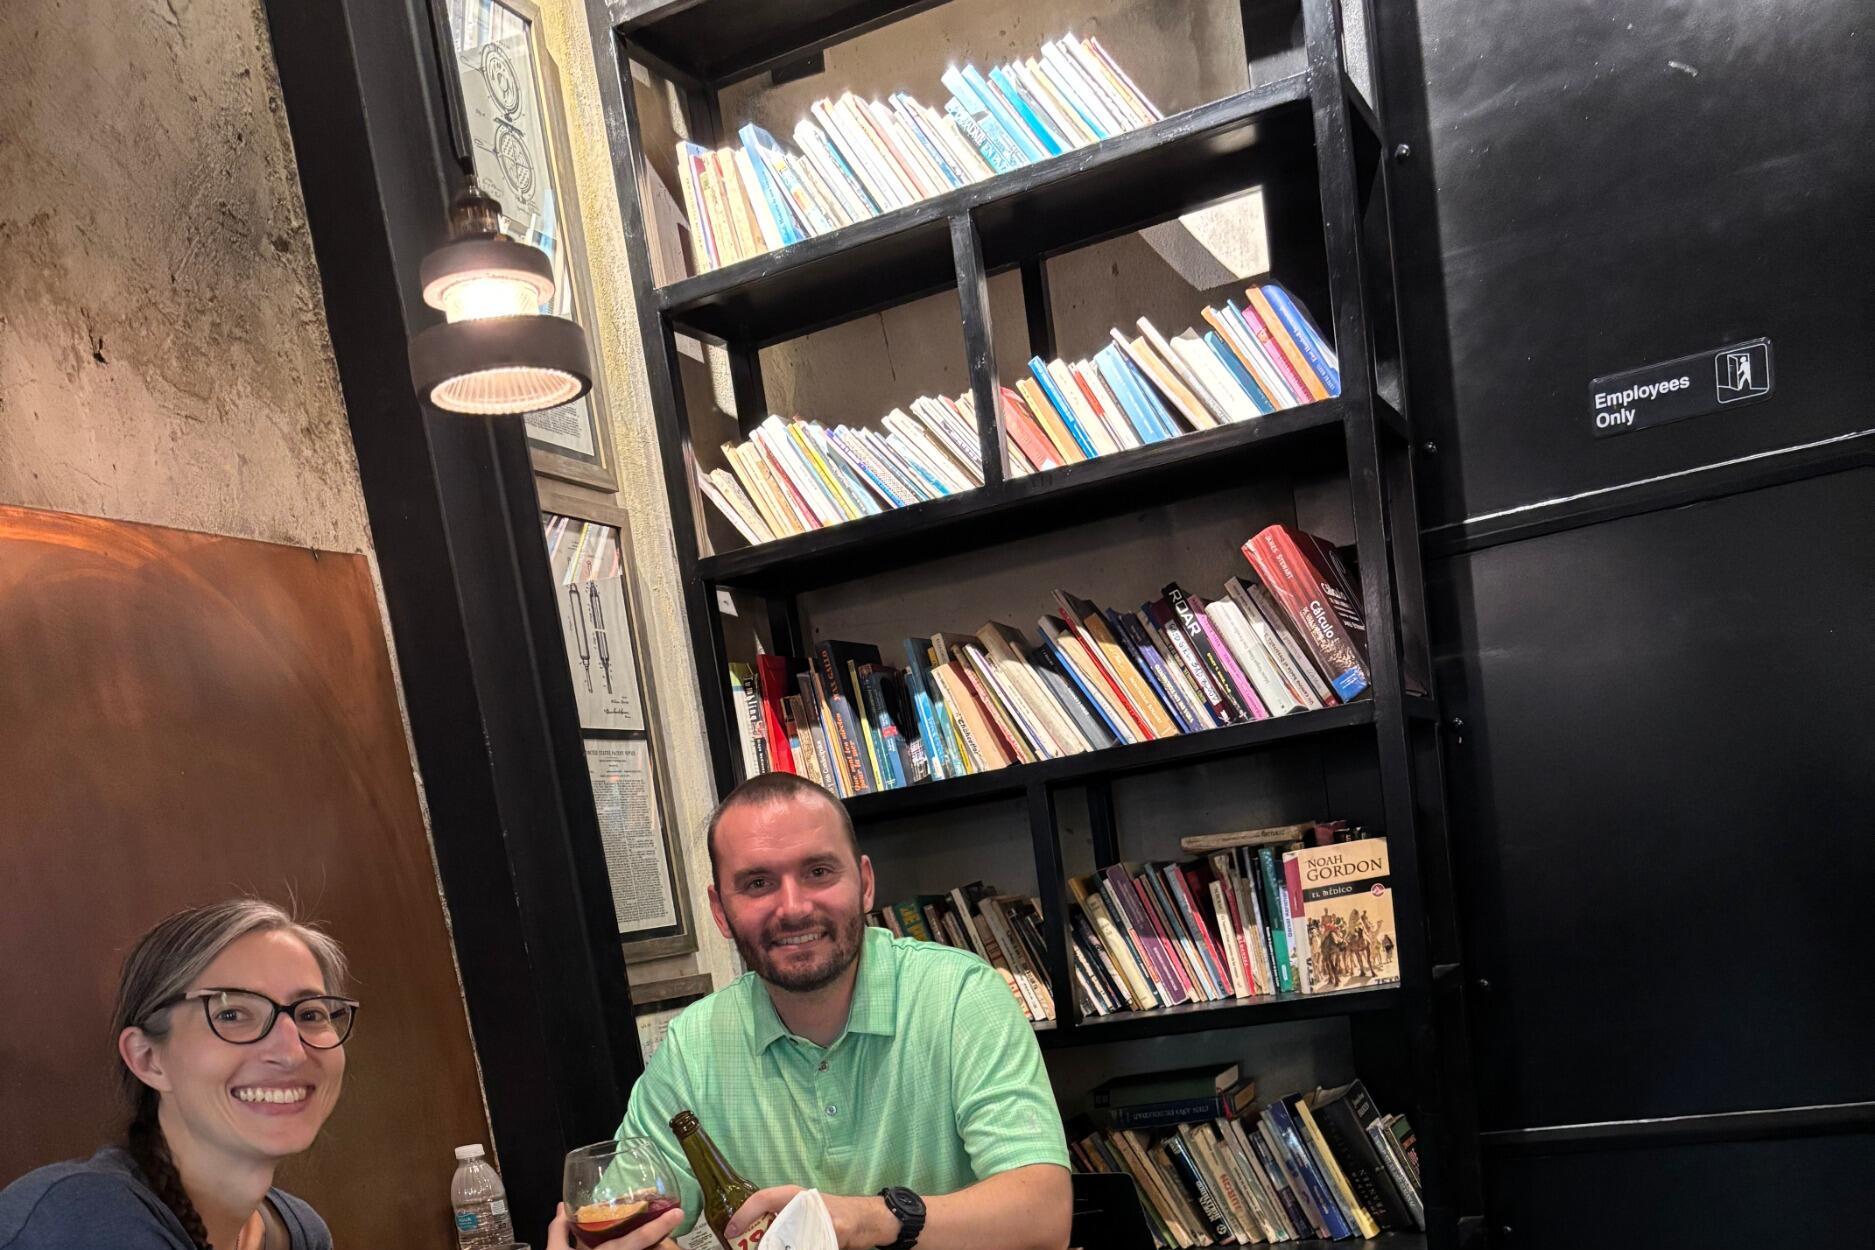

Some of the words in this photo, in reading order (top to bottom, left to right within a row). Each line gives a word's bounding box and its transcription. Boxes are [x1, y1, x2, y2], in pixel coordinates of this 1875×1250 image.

[1595, 376, 1690, 408] Employees
[1596, 407, 1636, 428] Only
[1265, 535, 1278, 554] JAMES
[1277, 553, 1294, 580] STEWART
[1168, 589, 1202, 636] ROAR
[1310, 600, 1334, 639] Cálculo
[1306, 858, 1383, 882] GORDON
[1307, 854, 1343, 869] NOAH
[1322, 886, 1352, 898] MÉDICO
